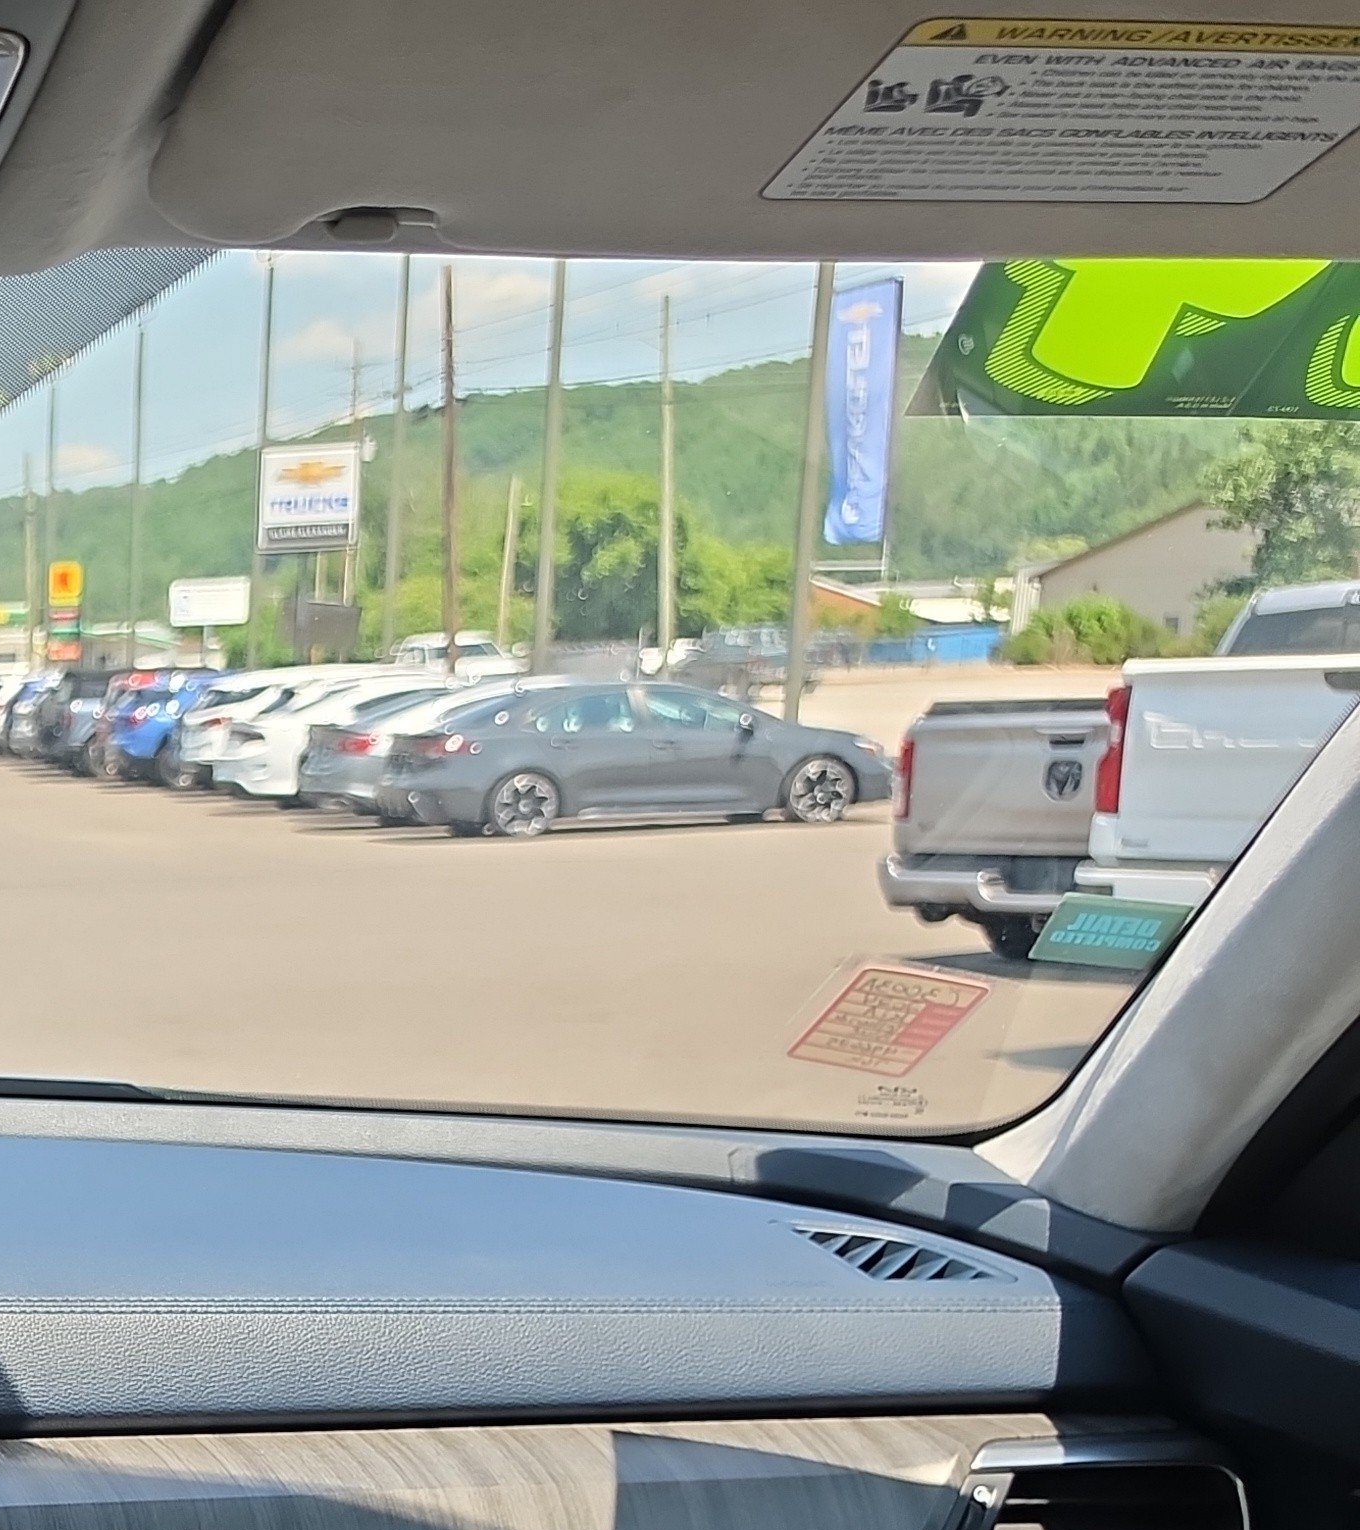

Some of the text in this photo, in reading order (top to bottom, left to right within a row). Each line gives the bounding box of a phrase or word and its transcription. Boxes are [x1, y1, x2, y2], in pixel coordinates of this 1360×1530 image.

[996, 27, 1152, 42] WARNING
[974, 54, 1037, 65] EVEN
[1045, 55, 1105, 66] WITH
[1111, 57, 1240, 68] ADVANCED
